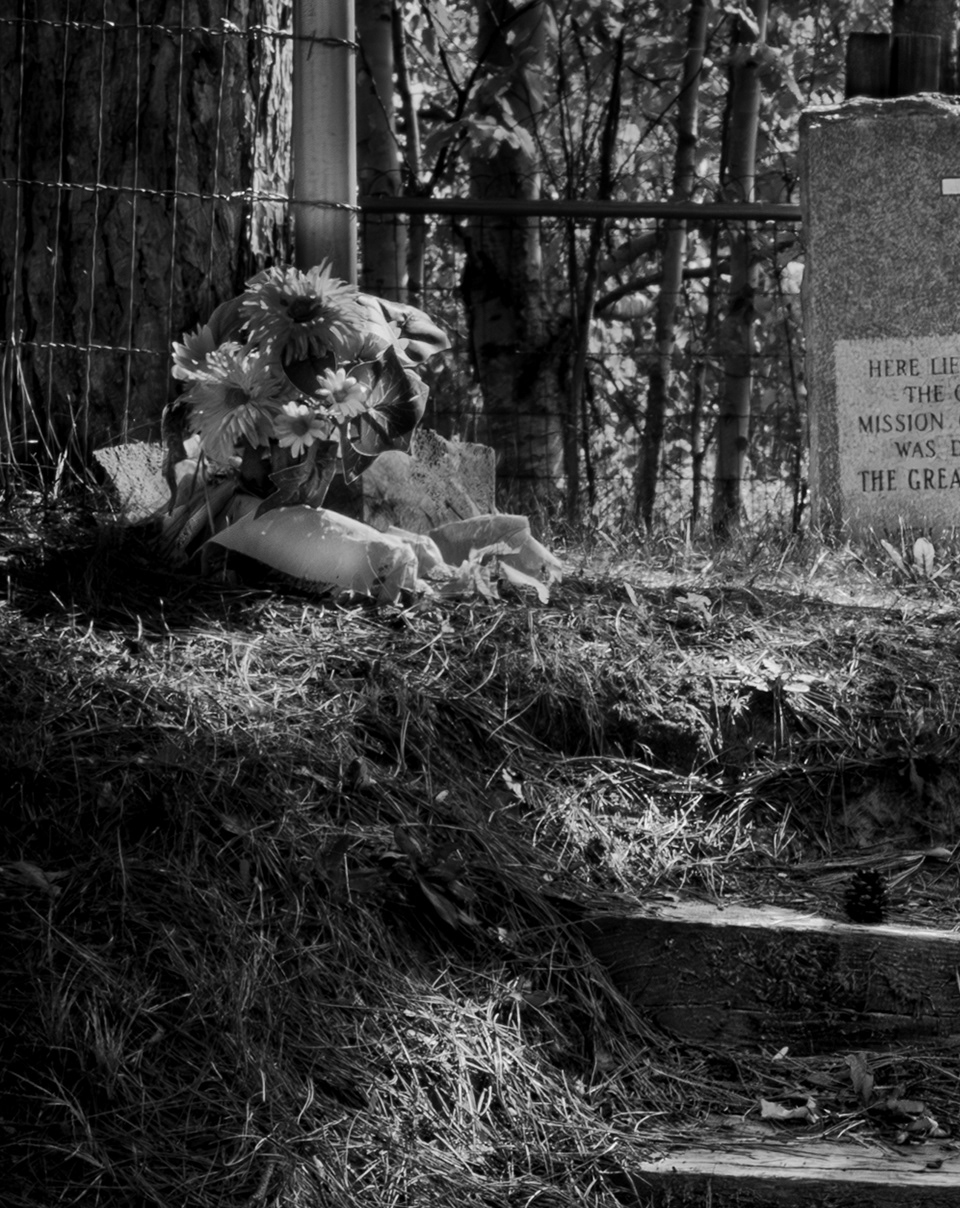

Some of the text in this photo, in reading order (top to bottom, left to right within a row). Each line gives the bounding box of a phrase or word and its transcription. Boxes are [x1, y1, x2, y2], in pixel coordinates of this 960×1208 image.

[869, 360, 919, 378] HERE
[931, 357, 958, 374] LIE
[904, 385, 943, 403] THE
[858, 413, 943, 433] MISSION
[895, 440, 936, 458] WAS
[858, 469, 896, 491] THE
